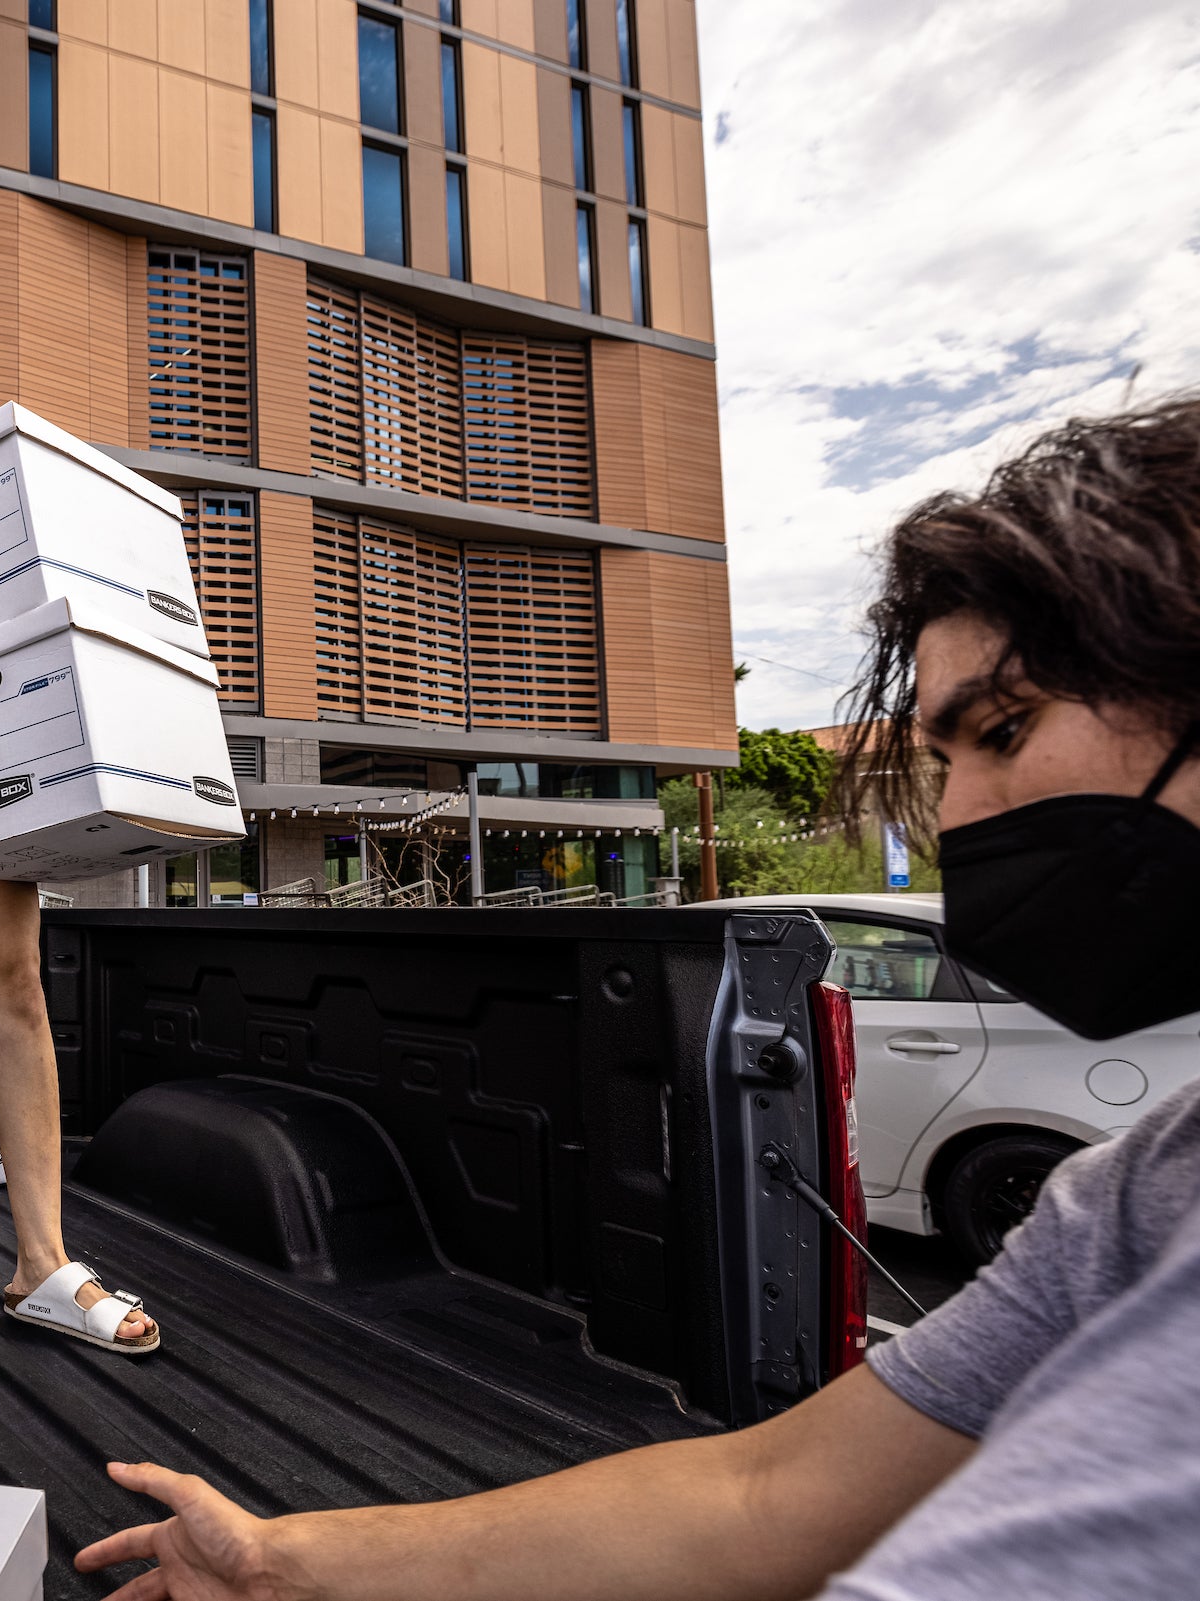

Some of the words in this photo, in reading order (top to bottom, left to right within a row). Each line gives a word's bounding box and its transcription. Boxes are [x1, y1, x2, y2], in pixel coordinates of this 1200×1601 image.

[150, 595, 182, 615] BANKERS
[182, 608, 196, 621] BOX
[1, 782, 27, 798] BOX
[196, 783, 223, 797] BANKERS
[222, 790, 235, 801] BOX
